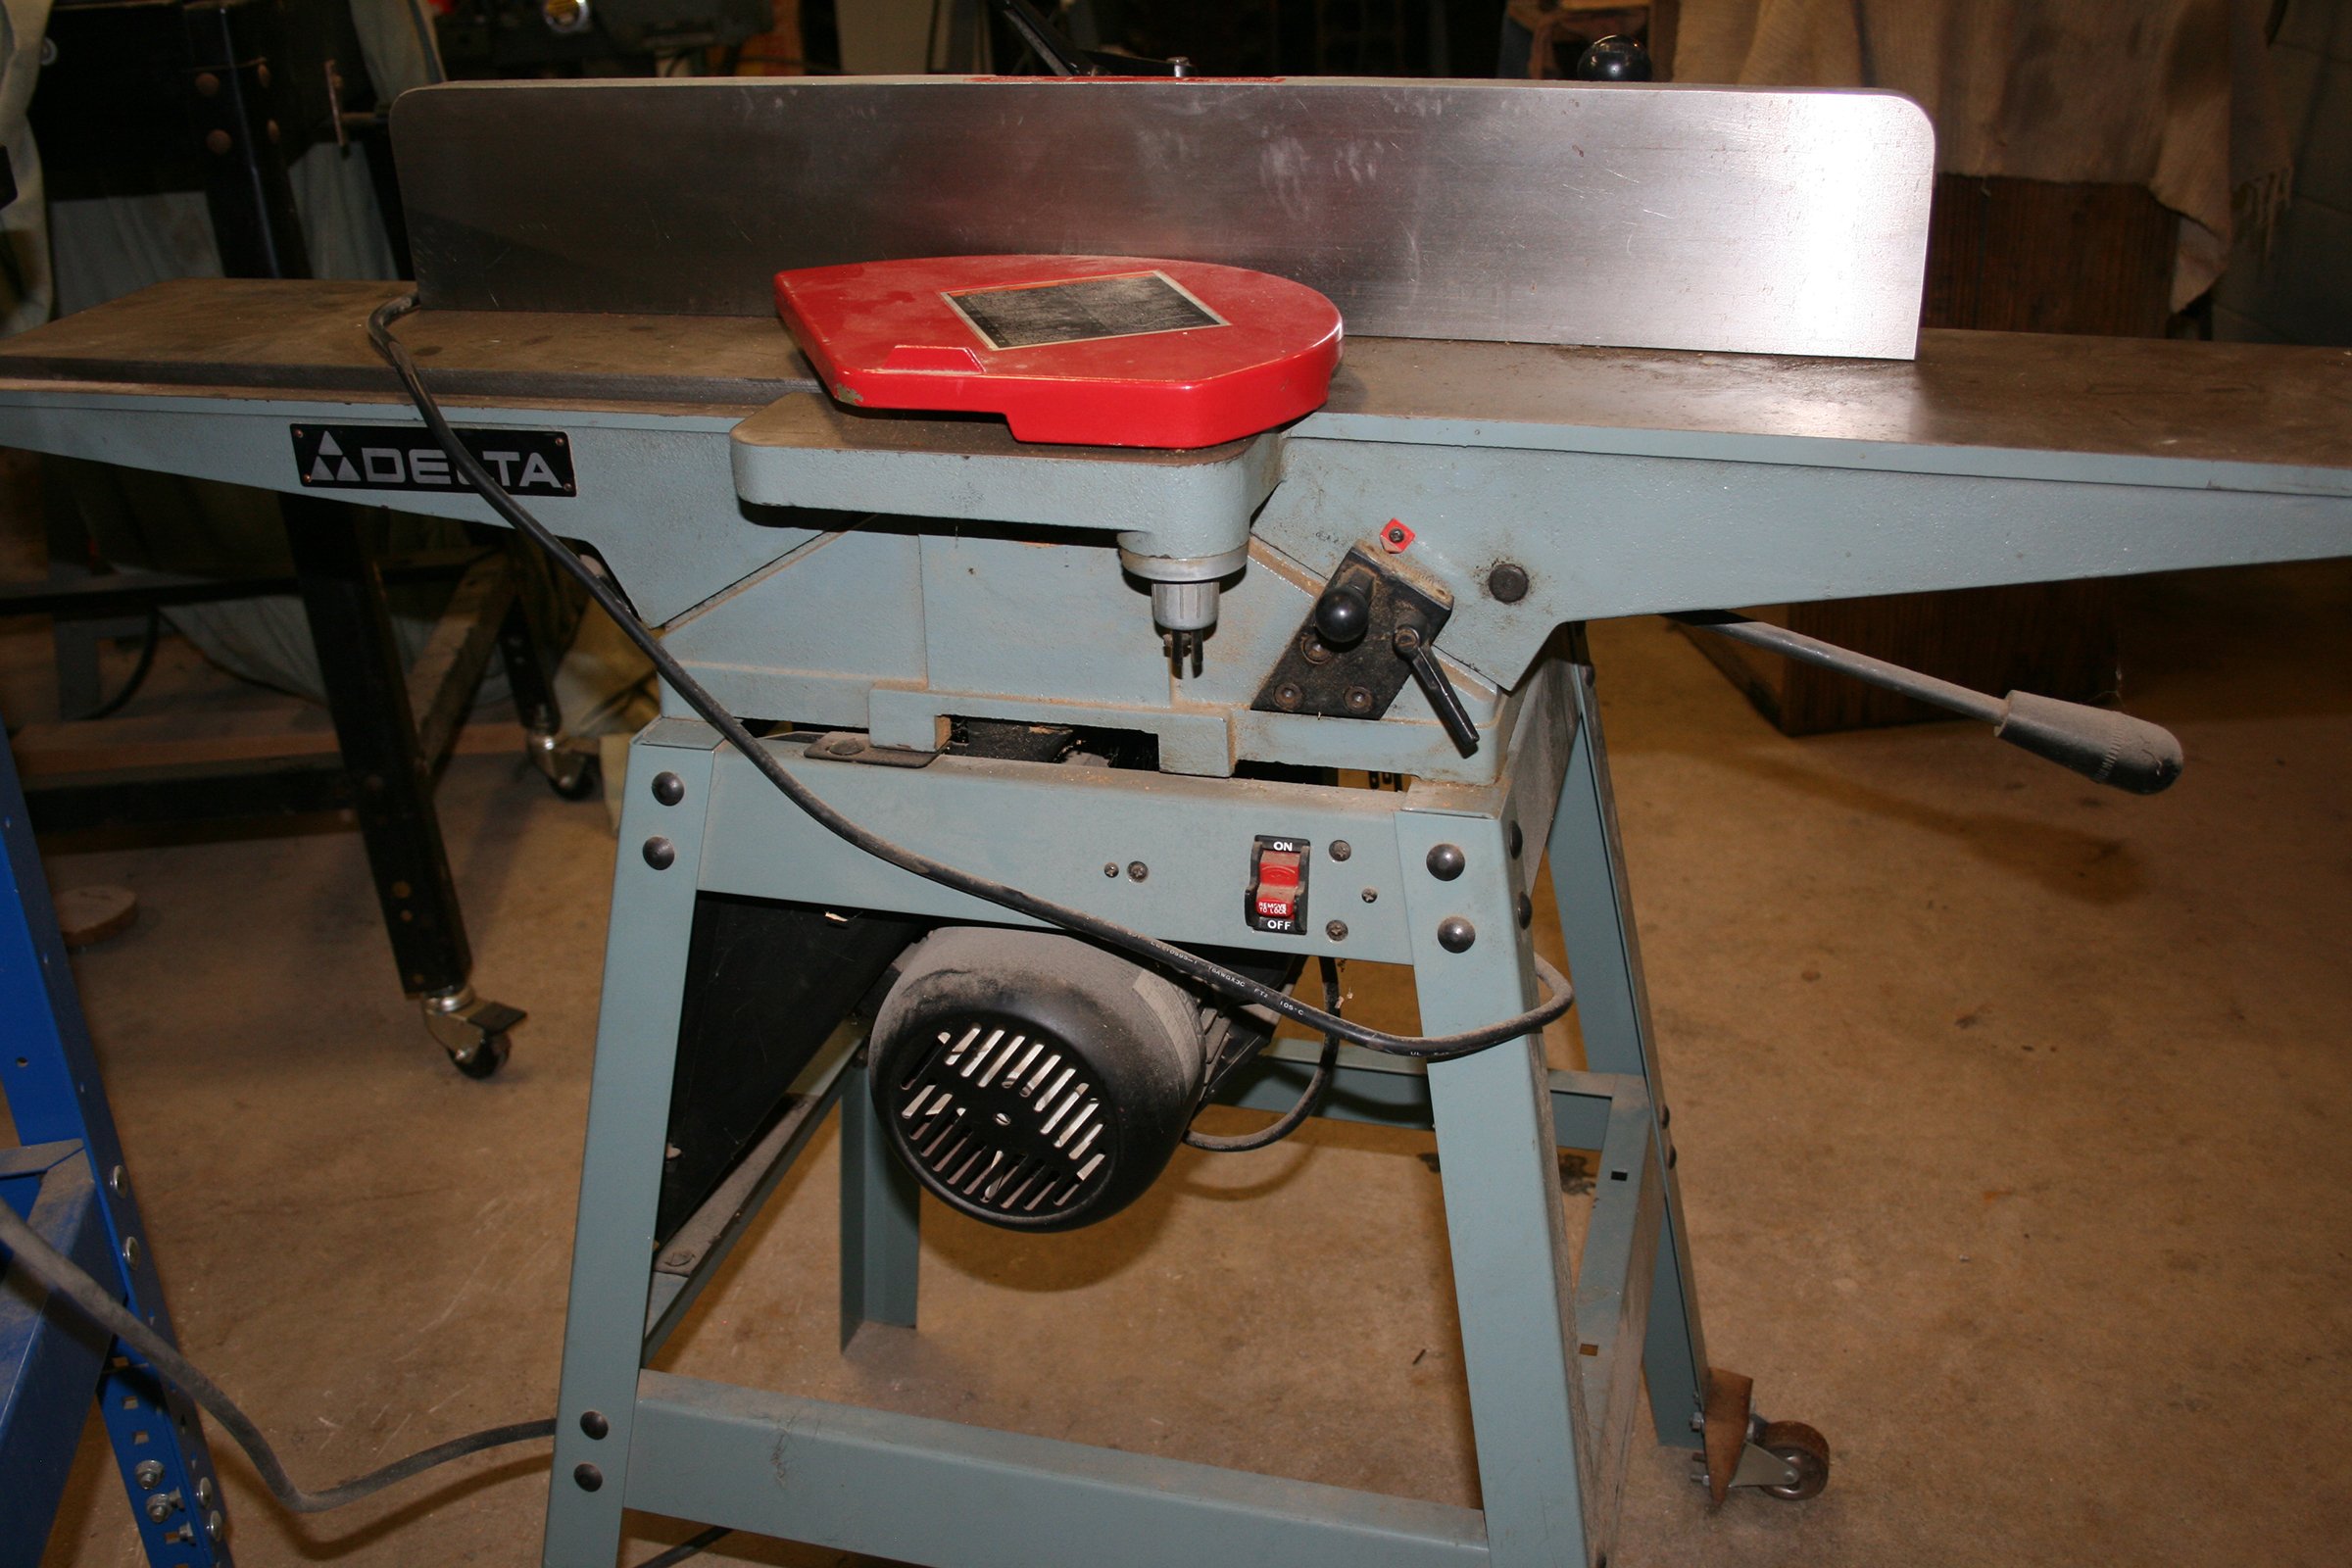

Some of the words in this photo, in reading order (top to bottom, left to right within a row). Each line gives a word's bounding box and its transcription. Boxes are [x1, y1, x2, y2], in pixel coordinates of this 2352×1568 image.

[1273, 841, 1293, 852] ON
[1258, 902, 1286, 910] REMOVE
[1267, 919, 1292, 931] OFF
